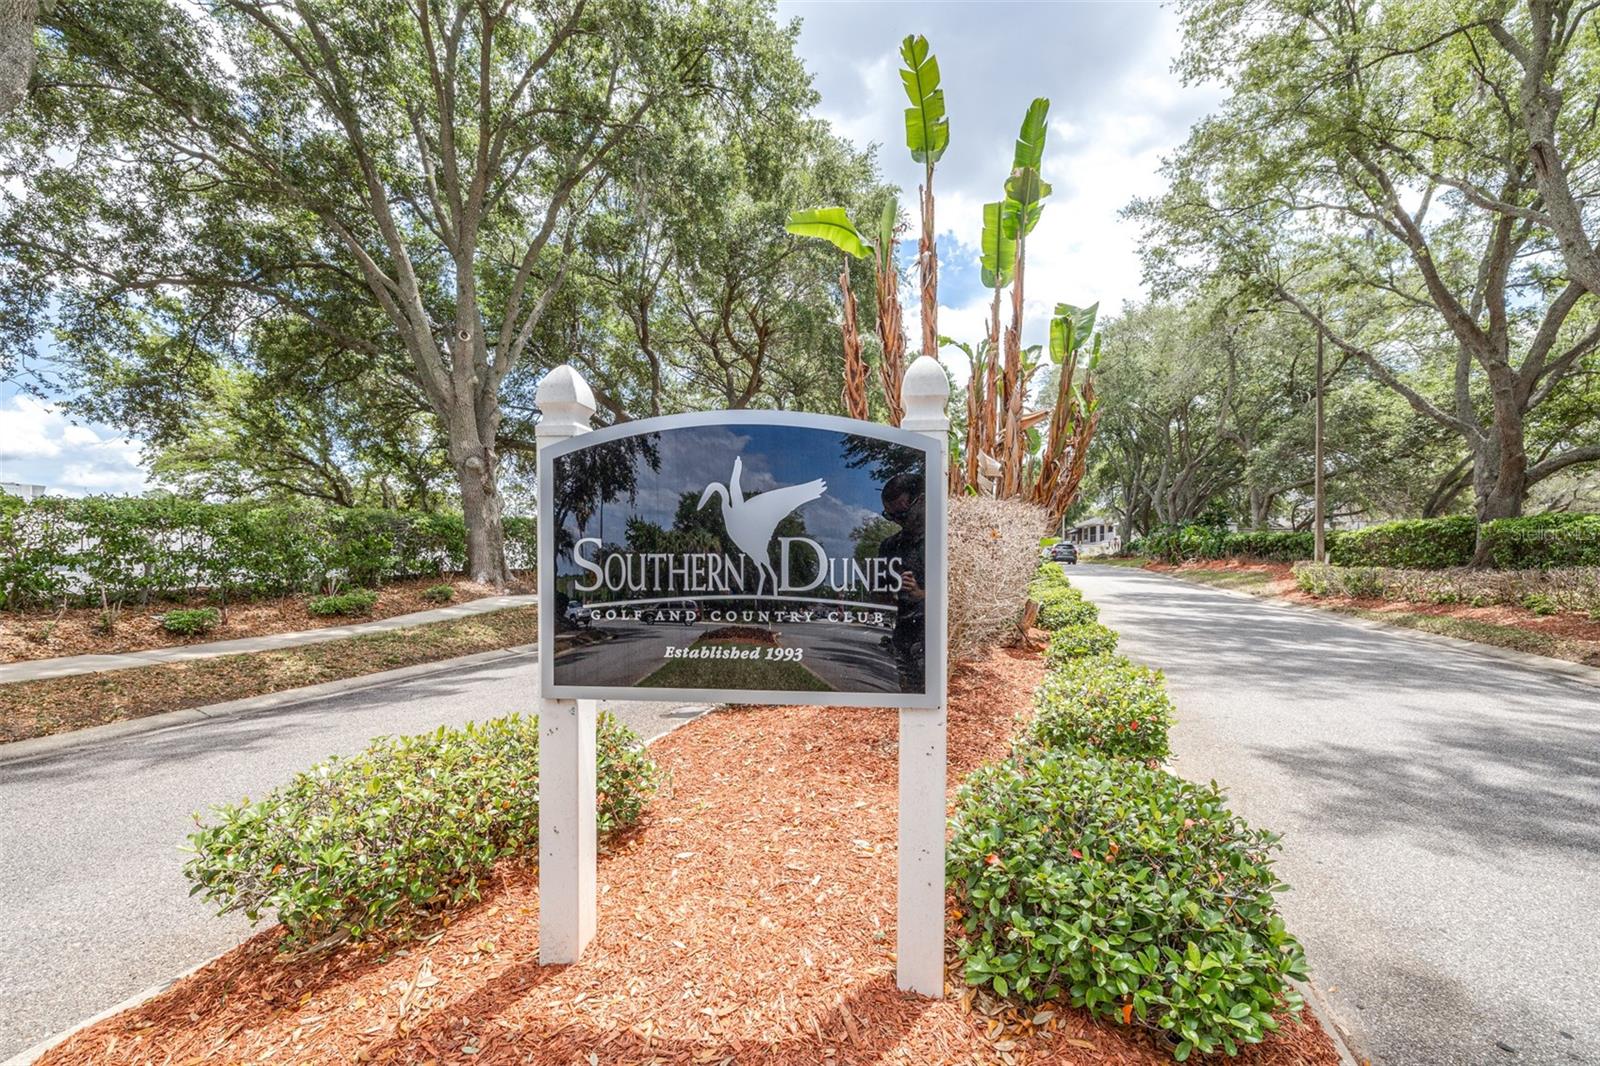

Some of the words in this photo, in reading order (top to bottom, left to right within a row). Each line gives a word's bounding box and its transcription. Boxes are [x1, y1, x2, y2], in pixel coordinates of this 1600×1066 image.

[573, 537, 746, 592] SOUTHERN
[777, 536, 903, 593] DUNES
[590, 609, 642, 621] GOLF
[654, 610, 697, 622] AND
[710, 610, 815, 623] COUNTRY
[828, 611, 884, 624] CLUB
[663, 646, 760, 660] Established
[765, 647, 804, 662] 1993
